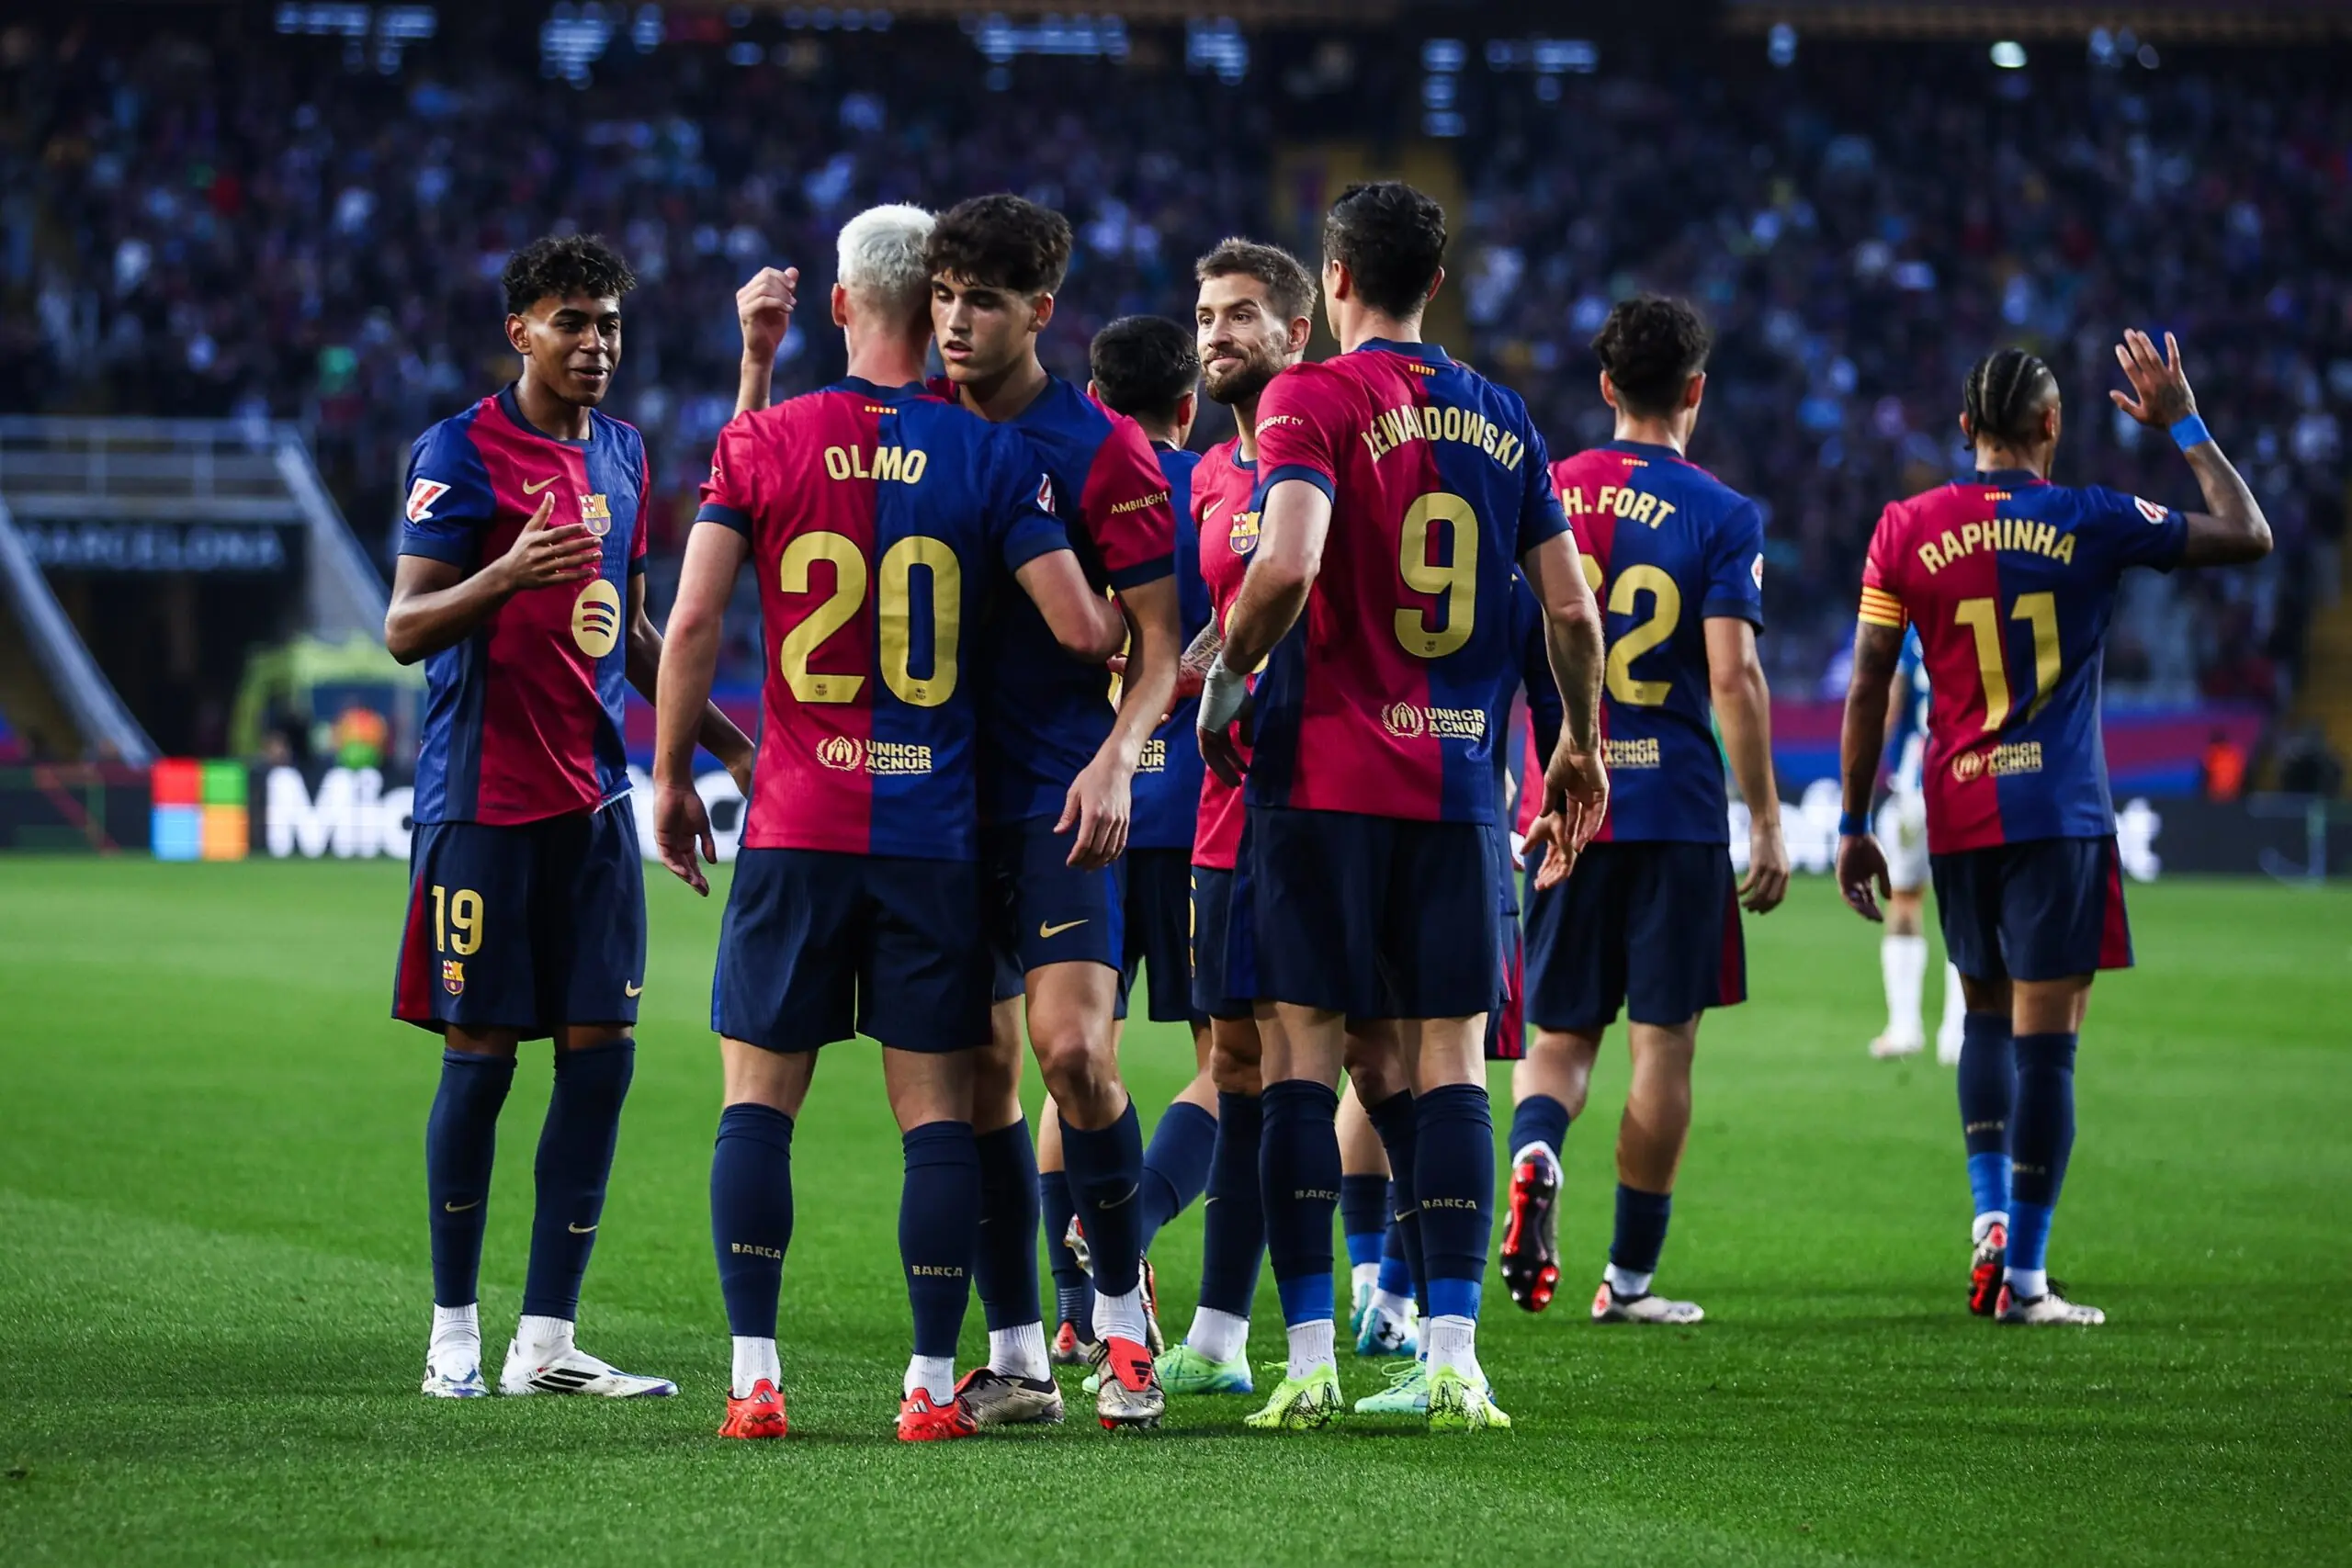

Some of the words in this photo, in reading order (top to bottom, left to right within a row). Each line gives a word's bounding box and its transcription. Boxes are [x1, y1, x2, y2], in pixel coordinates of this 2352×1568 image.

[1292, 417, 1304, 425] tv
[824, 445, 928, 484] OLMO
[1111, 491, 1168, 514] AMBILIGHT
[1562, 486, 1592, 517] H.
[1598, 485, 1676, 530] FORT
[1917, 518, 2076, 575] RAPHINHA
[1395, 491, 1478, 659] 9
[780, 531, 961, 707] 20
[1579, 553, 1680, 706] 2
[1954, 591, 2062, 732] 11
[1424, 706, 1486, 724] UNHCR
[1429, 720, 1485, 738] ACNUR
[865, 739, 932, 759] UNHCR
[865, 753, 932, 770] ACNUR
[431, 885, 484, 955] 19
